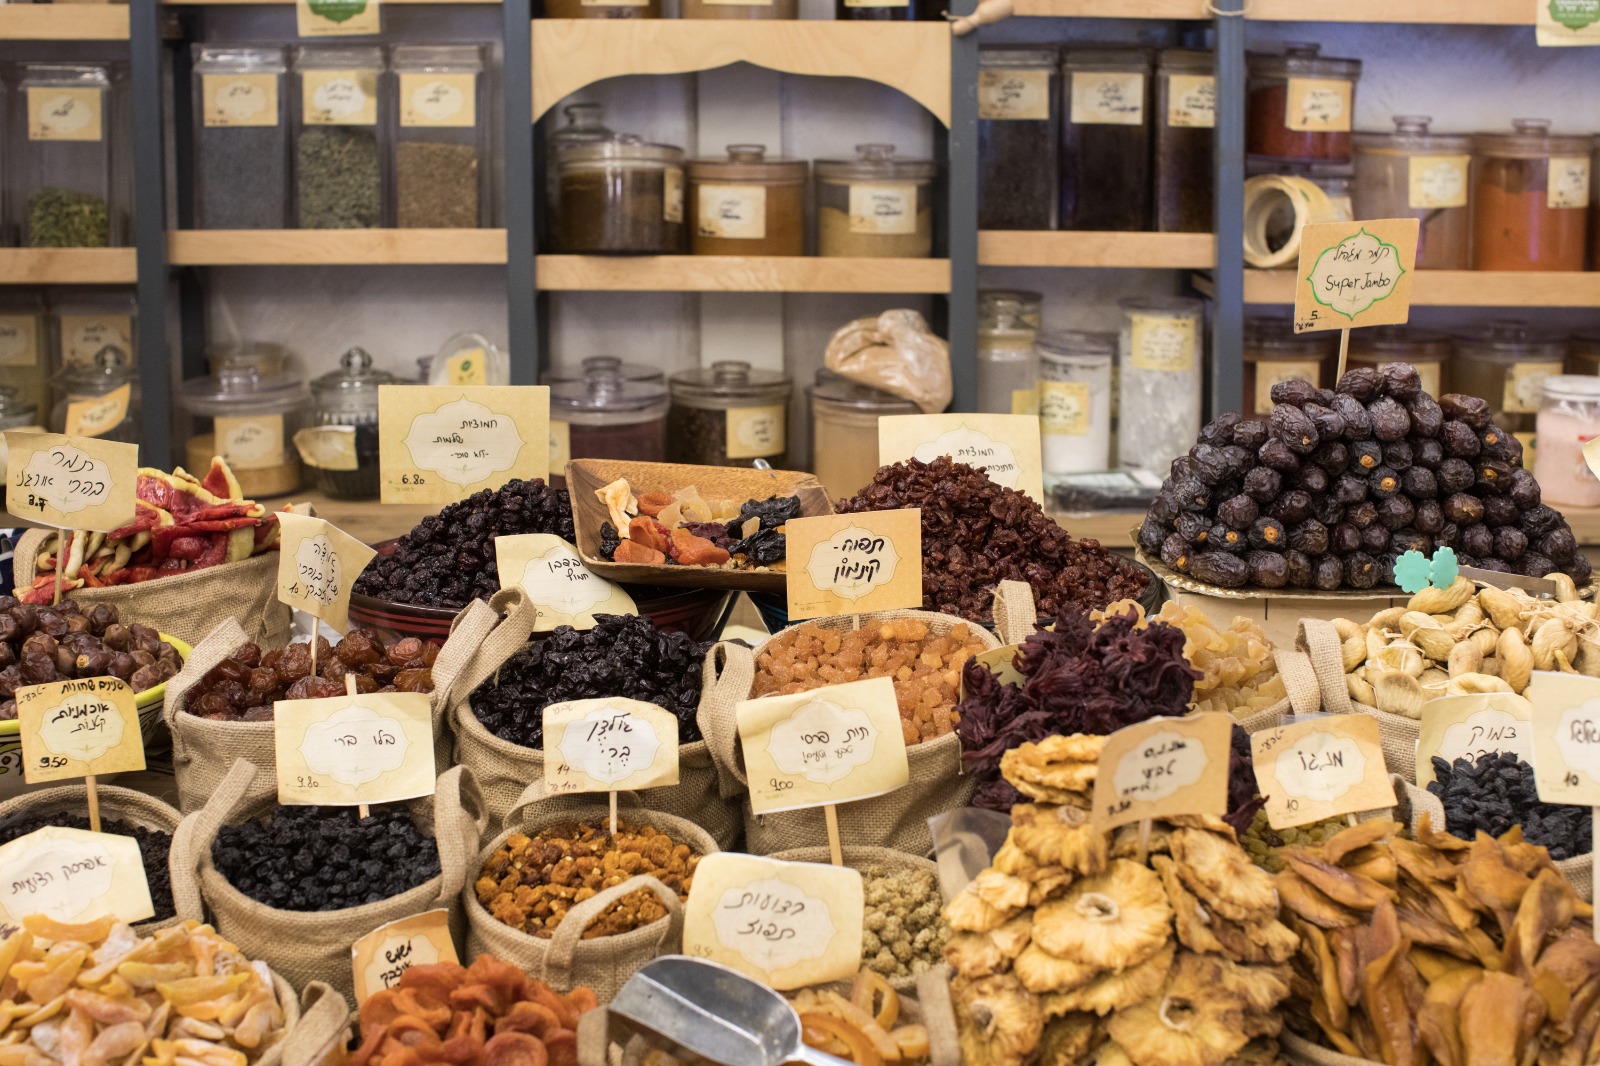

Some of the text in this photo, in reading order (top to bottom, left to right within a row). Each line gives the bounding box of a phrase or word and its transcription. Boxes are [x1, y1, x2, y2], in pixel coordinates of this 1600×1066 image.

[1325, 272, 1391, 296] Super Jambo
[460, 419, 498, 430] חמוציות
[432, 432, 464, 444] שלמות
[957, 446, 995, 457] חמוציות
[51, 451, 95, 473] תמר
[401, 474, 426, 486] 6.80
[334, 729, 396, 746] בלו ברי
[842, 726, 869, 744] תות
[1467, 726, 1517, 747] צמוק
[39, 756, 68, 769] 9.50
[557, 764, 570, 775] 14
[297, 775, 319, 788] 9.80
[1563, 771, 1579, 786] 10
[1285, 799, 1299, 812] 10
[61, 855, 107, 880] אפרסק
